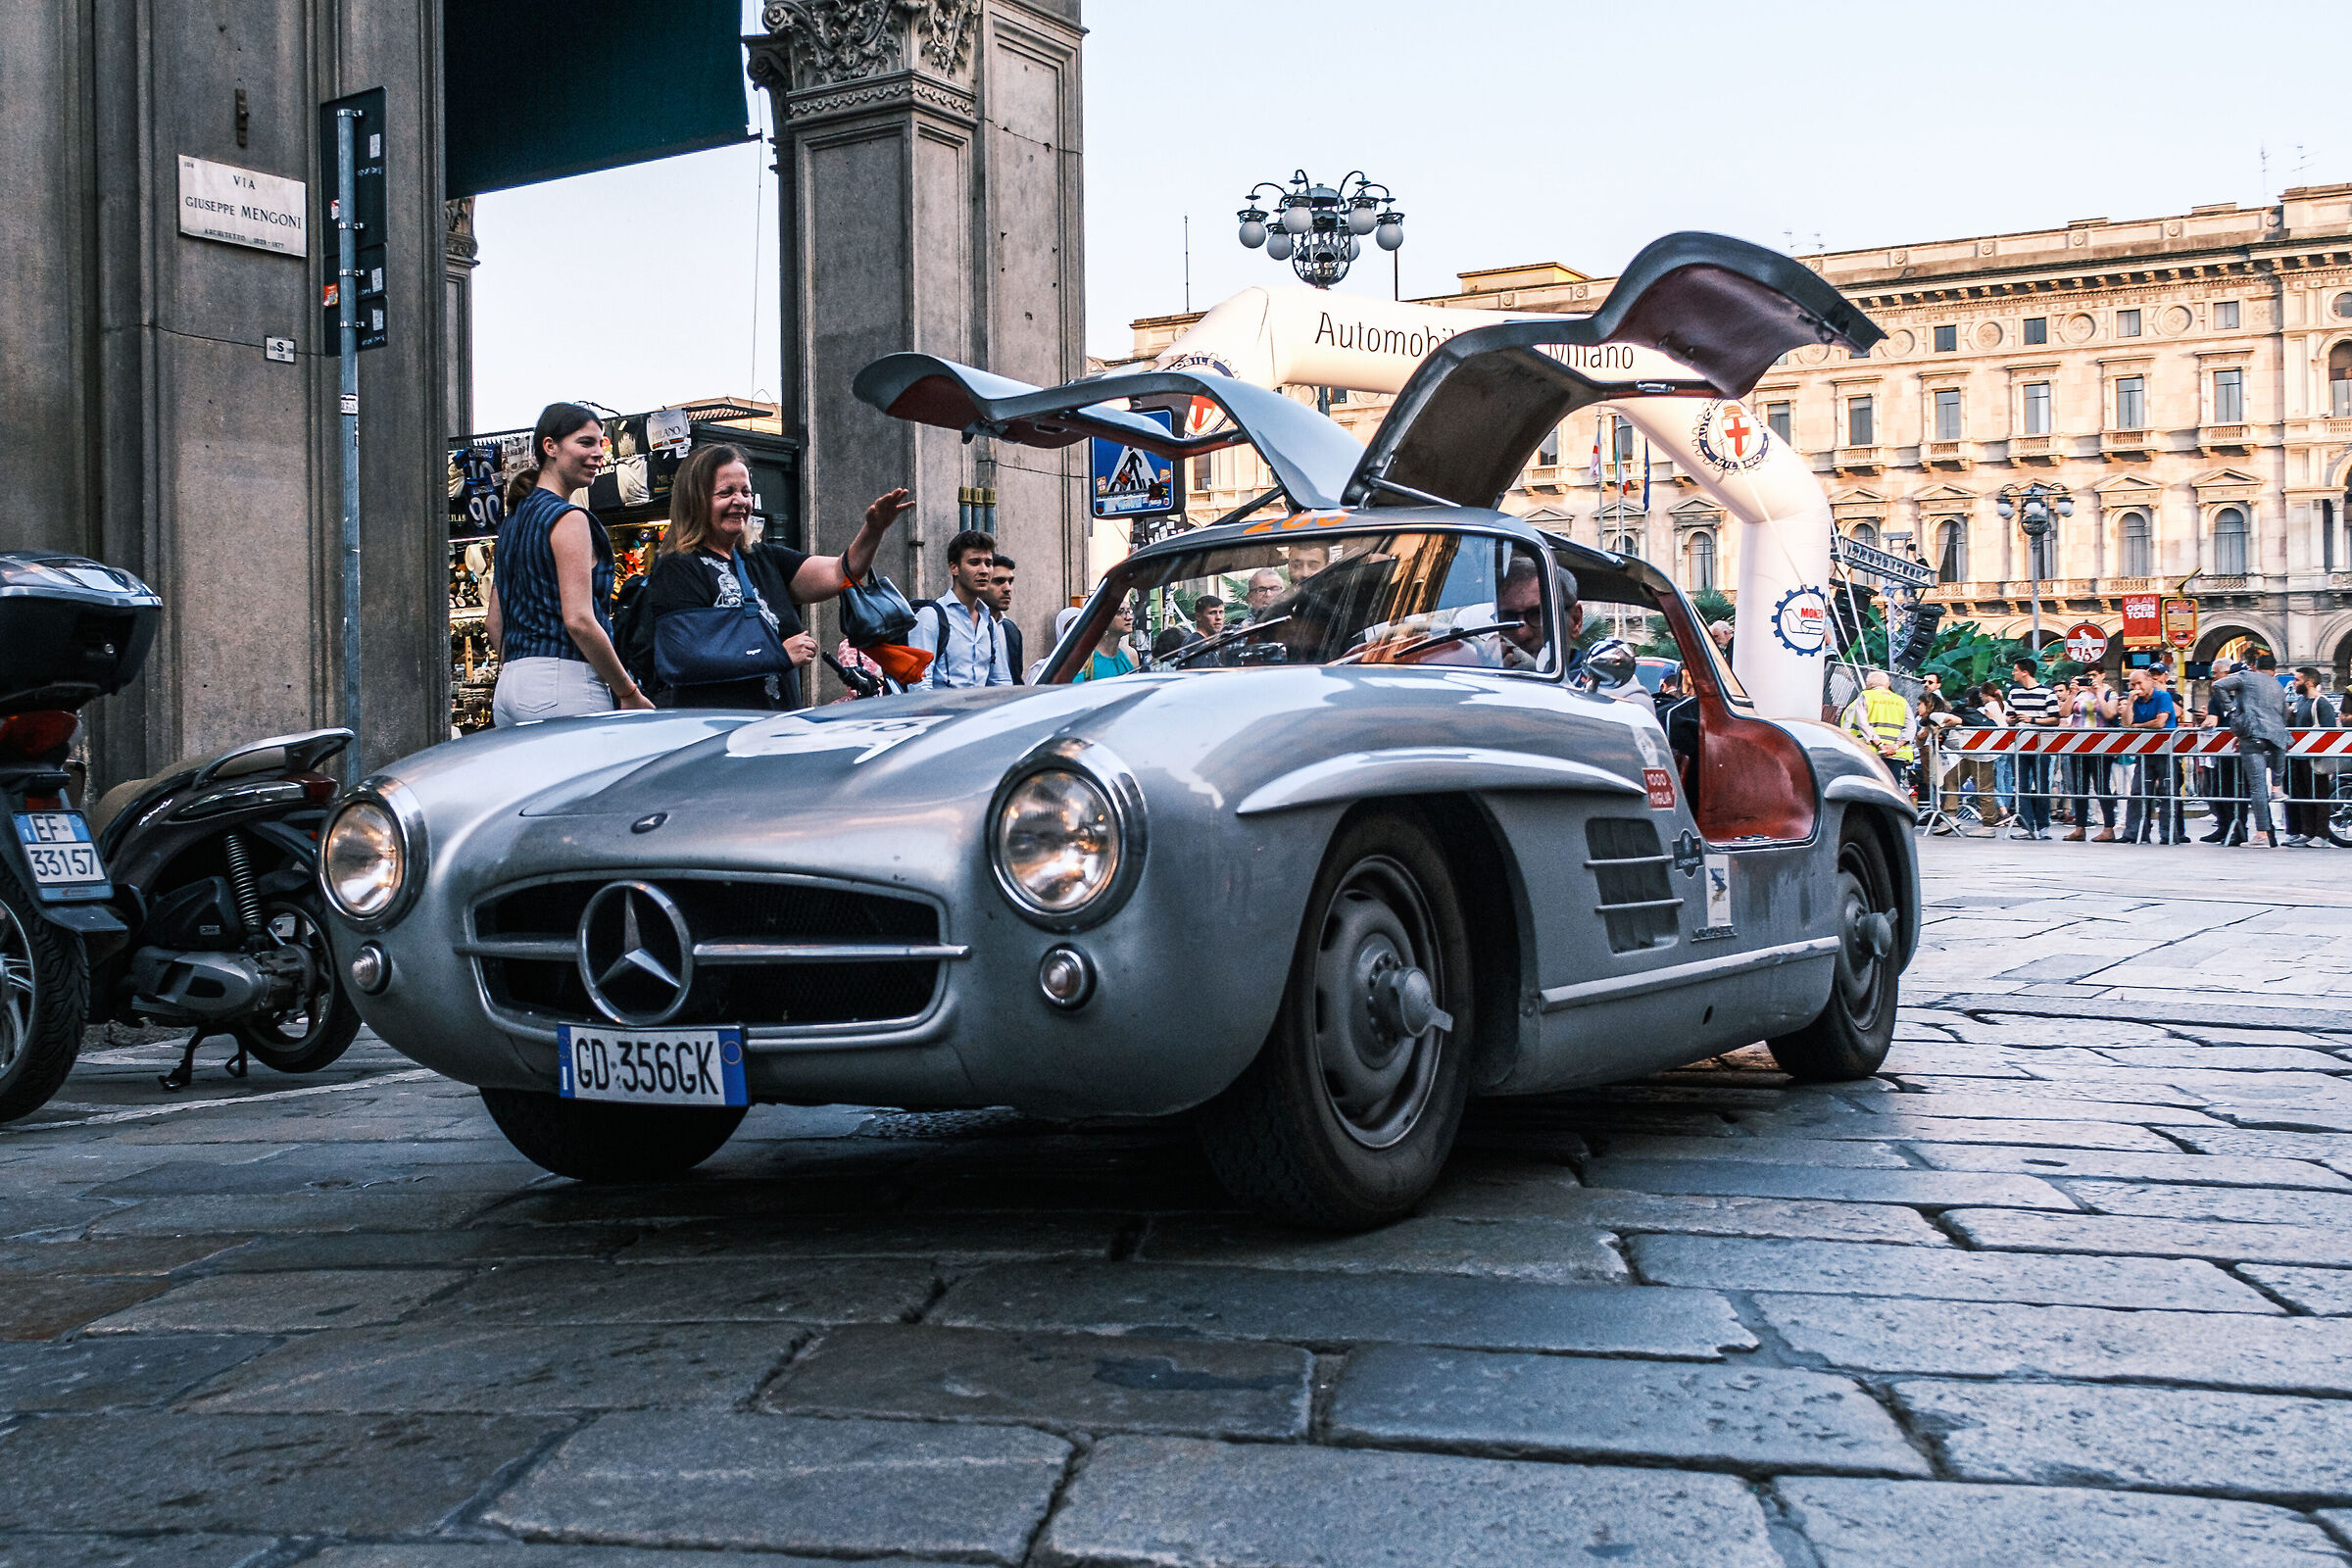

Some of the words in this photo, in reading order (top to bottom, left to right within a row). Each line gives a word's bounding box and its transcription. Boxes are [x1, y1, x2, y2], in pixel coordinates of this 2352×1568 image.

[233, 175, 256, 190] VIA
[184, 196, 235, 216] GIUSEPPE
[241, 205, 302, 229] MENGONI
[1315, 311, 1455, 357] Automob
[276, 341, 284, 353] S
[1713, 453, 1763, 469] MILNO
[2125, 604, 2156, 612] OPEN
[2126, 611, 2156, 619] TOUR
[32, 814, 58, 842] EF
[30, 848, 94, 876] 33157
